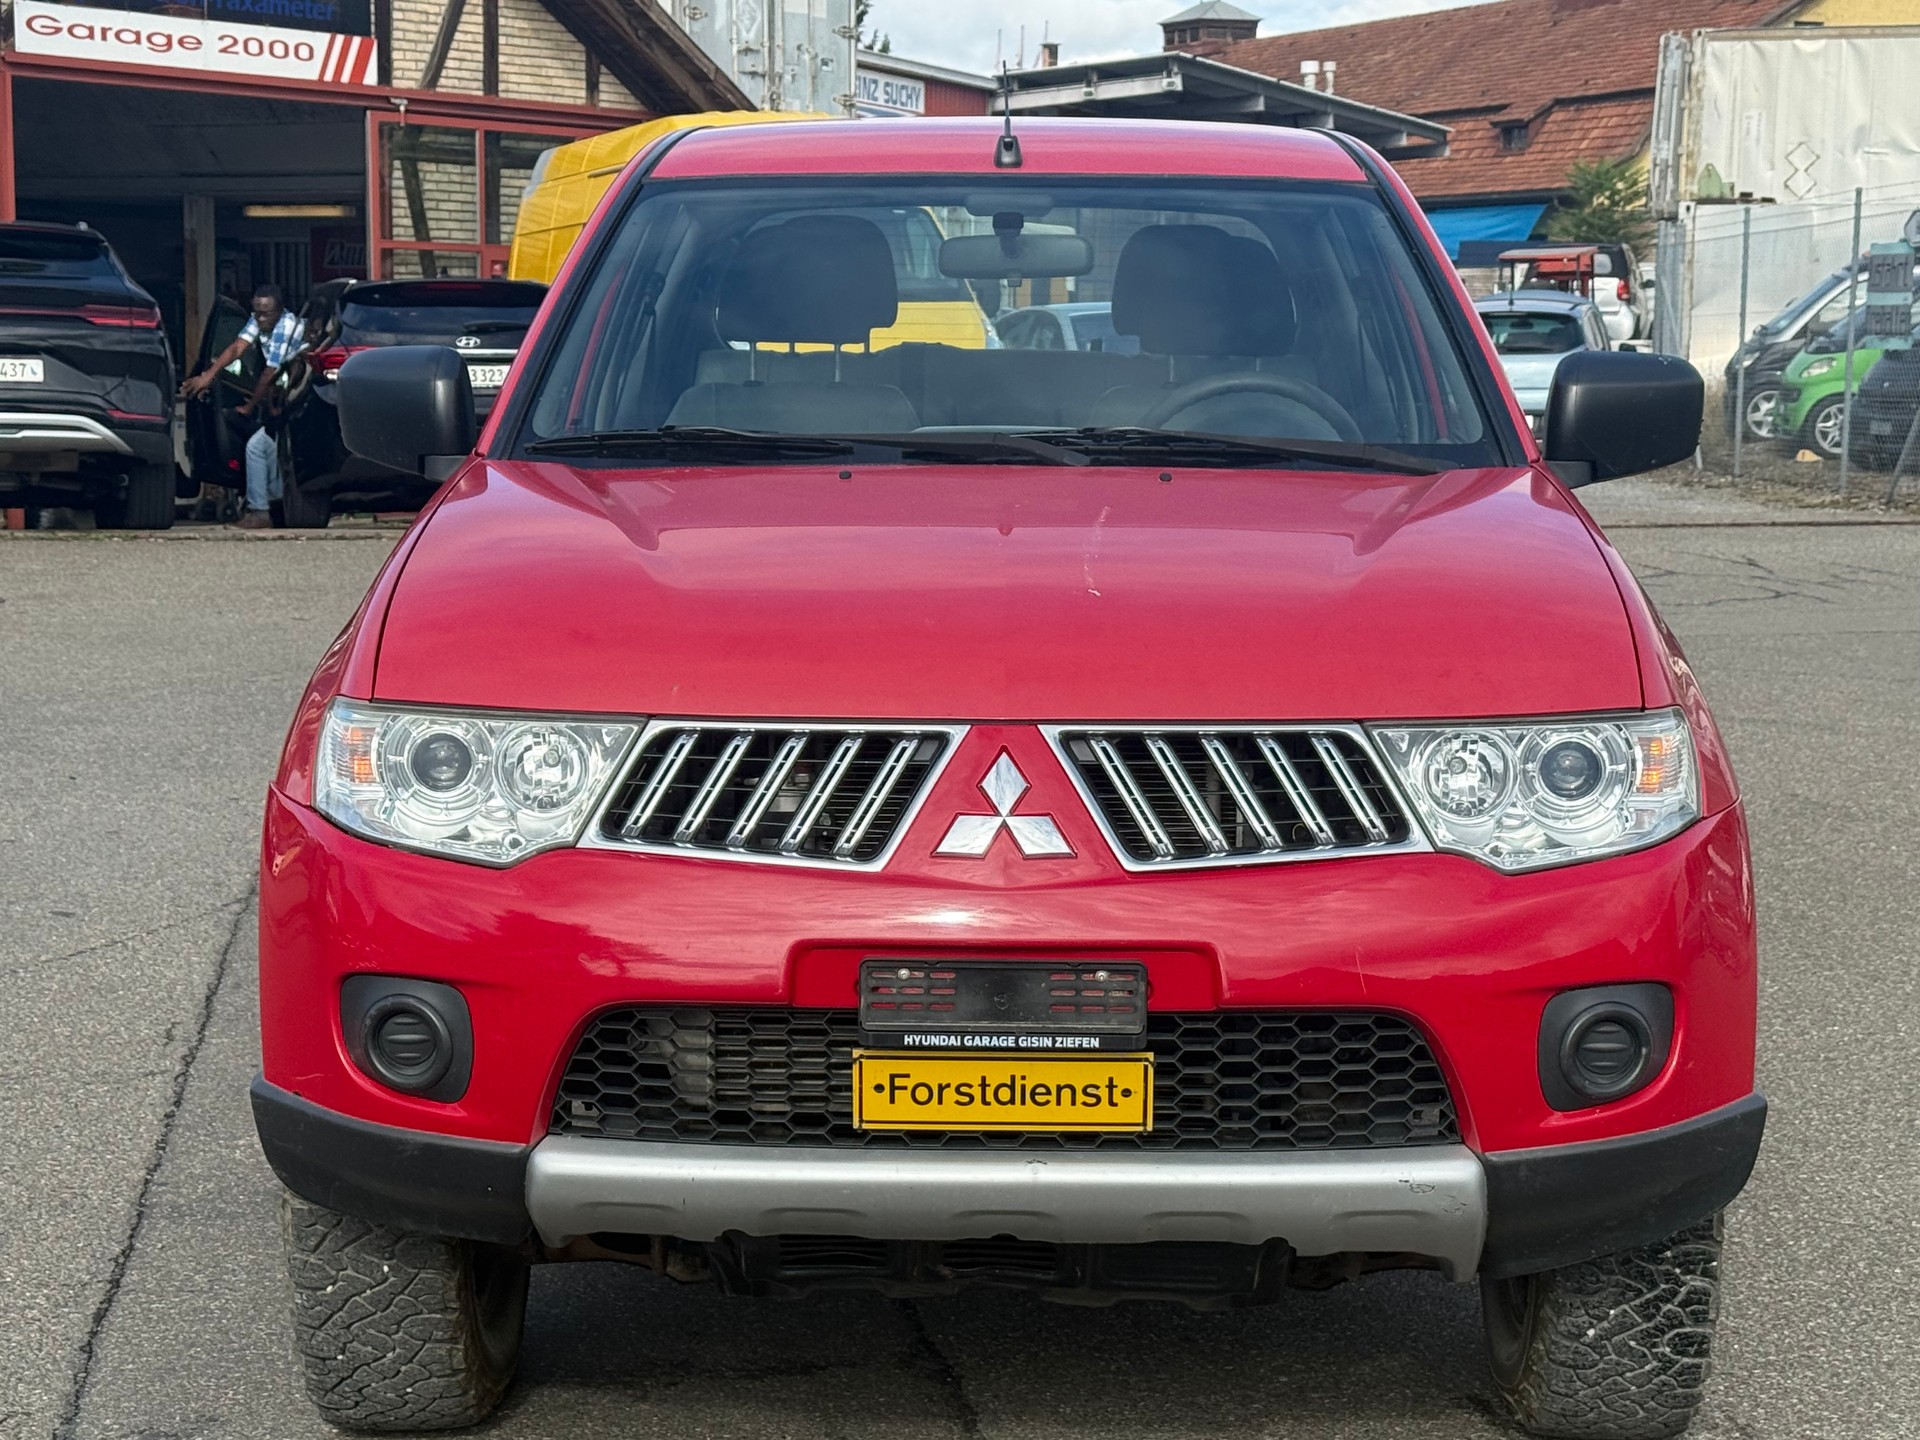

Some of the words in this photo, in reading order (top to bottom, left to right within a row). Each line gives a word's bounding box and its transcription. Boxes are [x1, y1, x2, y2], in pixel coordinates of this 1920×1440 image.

[25, 15, 203, 52] Garage
[217, 34, 314, 62] 2000
[883, 81, 921, 110] SUCHY
[904, 1035, 961, 1046] HYUNDAI
[963, 1035, 1015, 1047] GARAGE
[1018, 1036, 1052, 1047] GISIN
[1054, 1037, 1099, 1048] ZIEFEN
[888, 1073, 1119, 1108] Forstdienst
